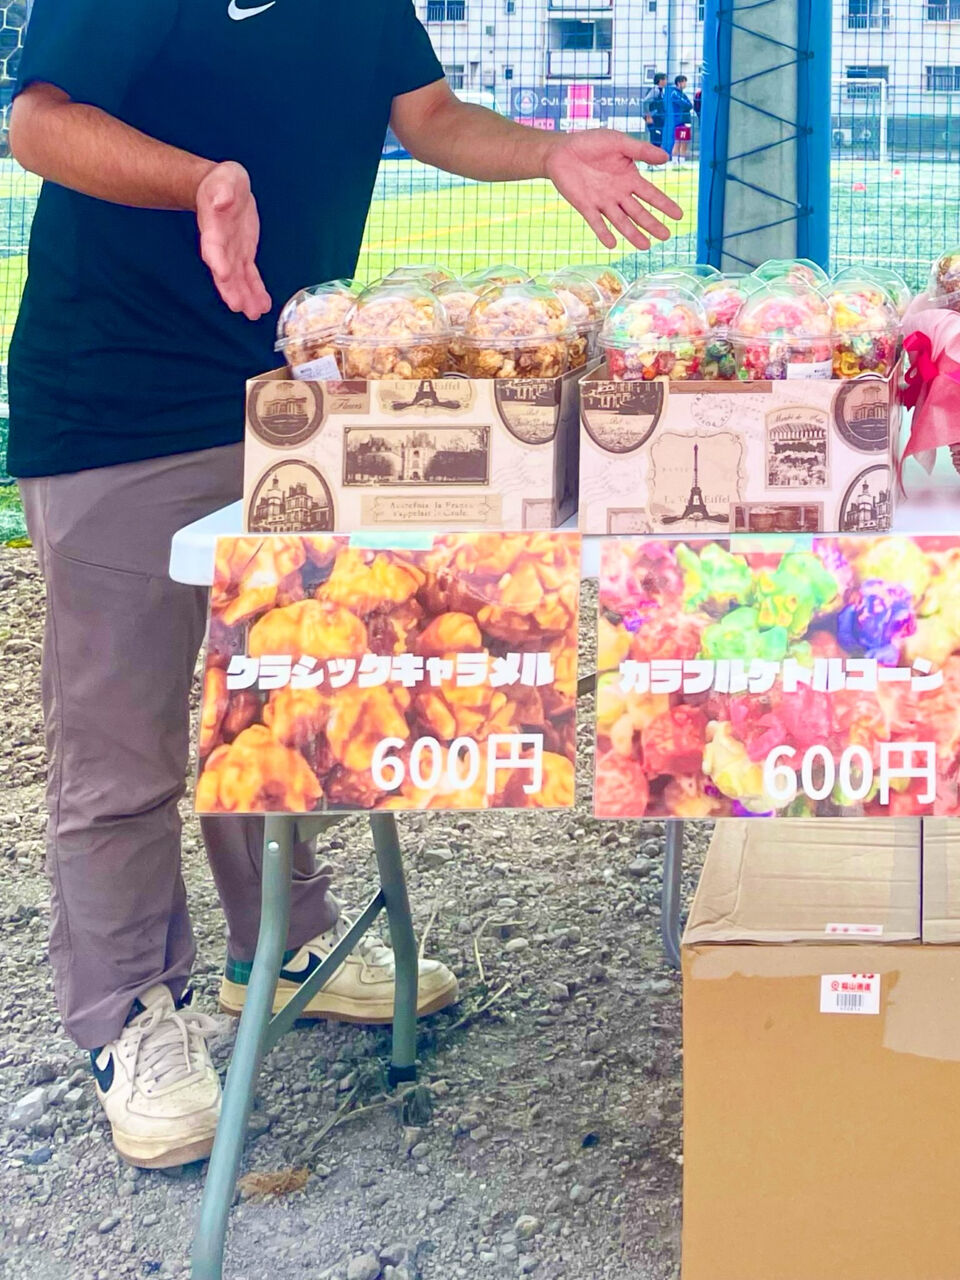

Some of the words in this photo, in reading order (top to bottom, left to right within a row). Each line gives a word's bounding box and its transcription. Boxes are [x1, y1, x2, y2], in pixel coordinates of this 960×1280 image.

[226, 651, 554, 690] クラシックキャラメル
[618, 658, 943, 695] カラフルケトルコーン
[370, 733, 544, 796] 600円
[763, 741, 938, 806] 600円
